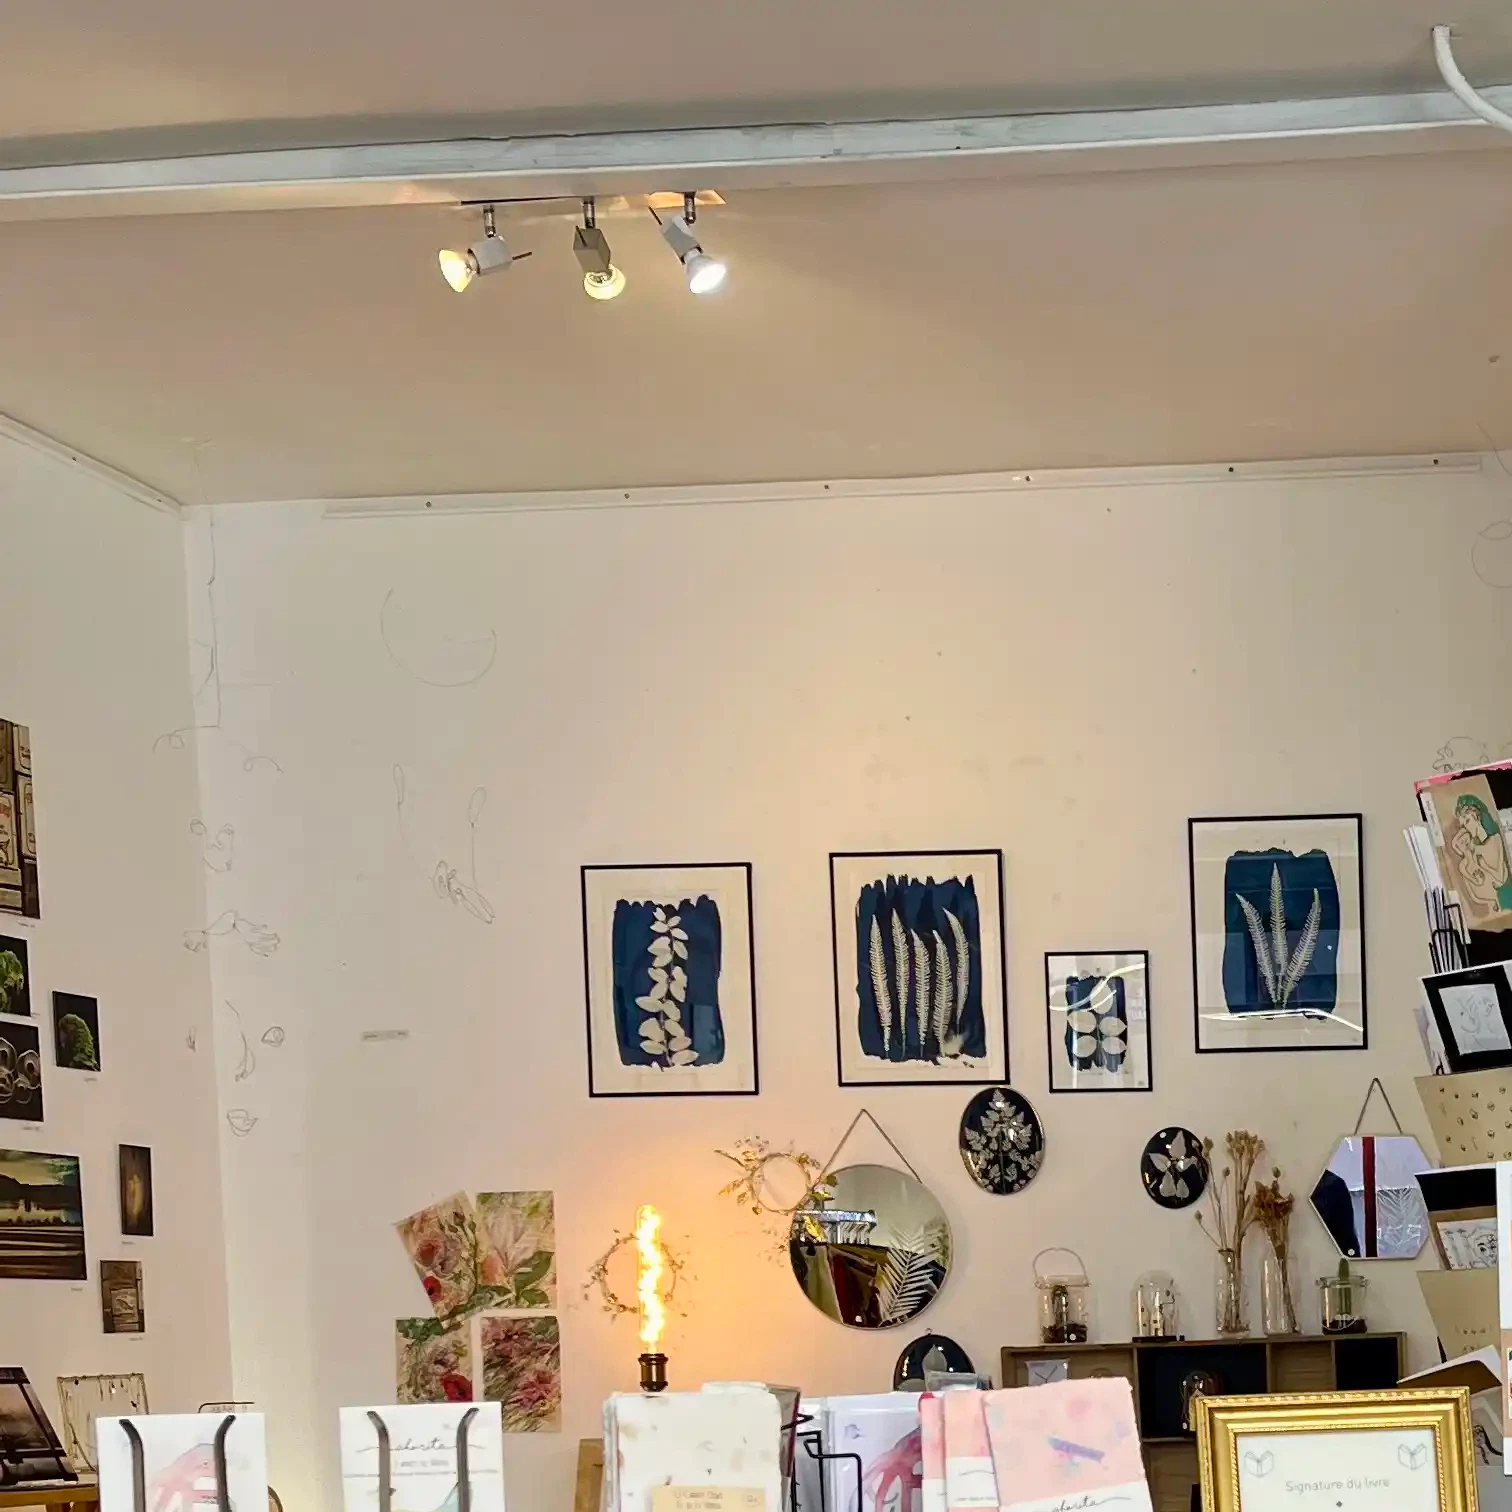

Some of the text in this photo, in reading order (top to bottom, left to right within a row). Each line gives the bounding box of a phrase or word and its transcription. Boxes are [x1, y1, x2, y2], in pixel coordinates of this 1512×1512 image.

[1285, 1477, 1391, 1496] Signature du livre
